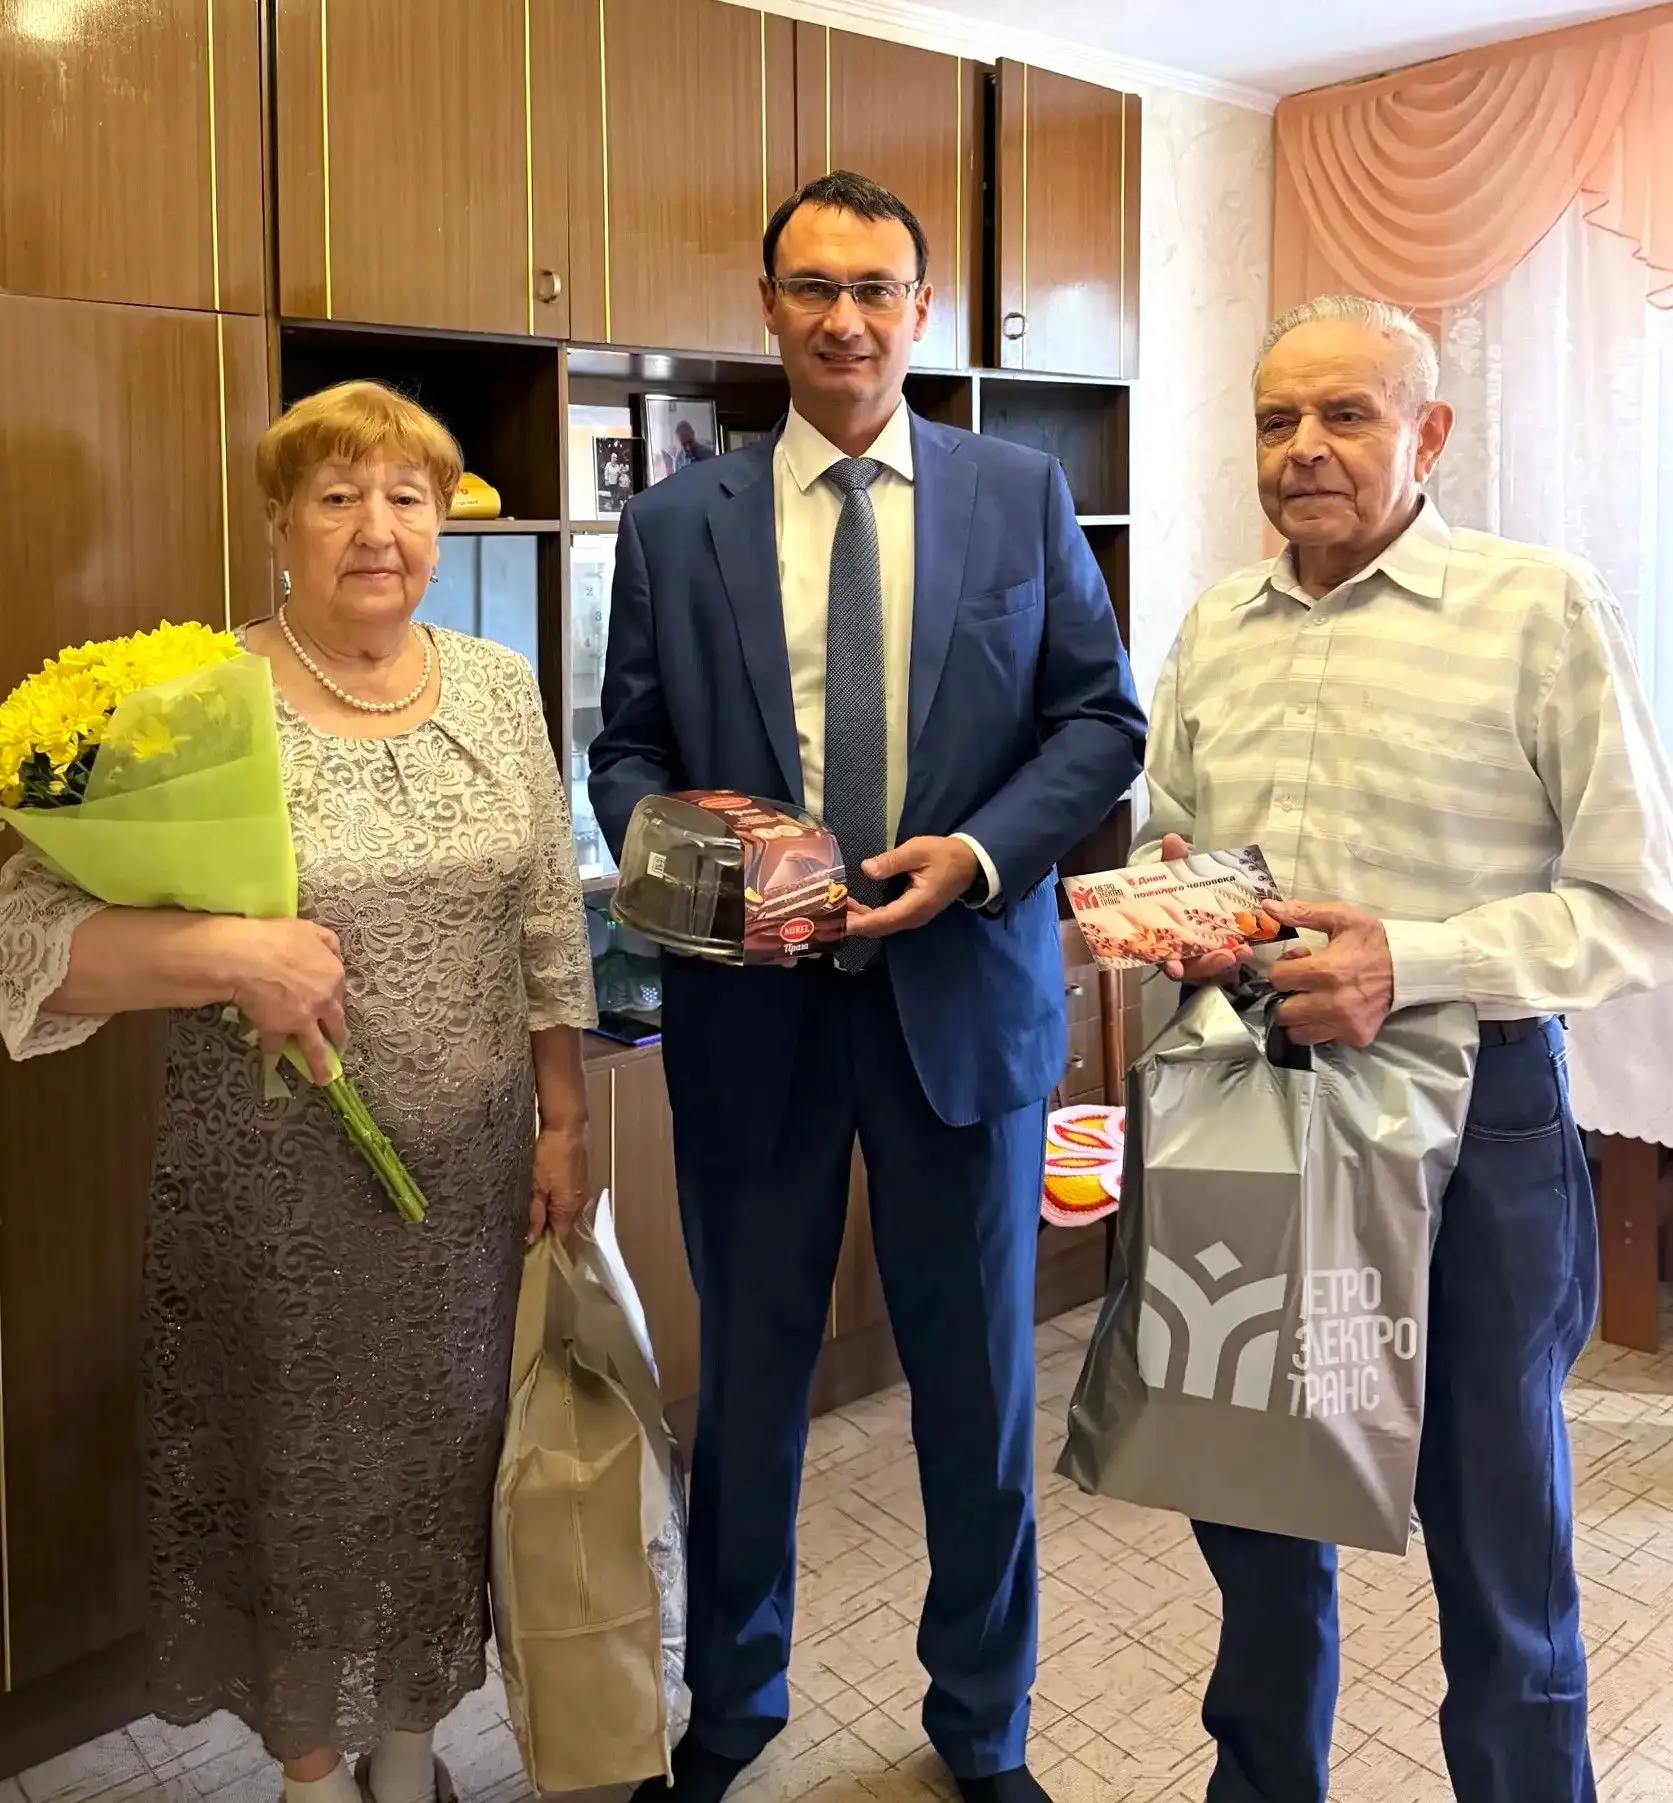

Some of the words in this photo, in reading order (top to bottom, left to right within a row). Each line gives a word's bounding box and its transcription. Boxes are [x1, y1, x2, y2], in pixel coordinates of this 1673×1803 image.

[1133, 885, 1185, 899] пожилого
[1187, 875, 1236, 889] человека
[784, 924, 810, 936] MIREL
[1287, 1365, 1380, 1419] ТРАНС
